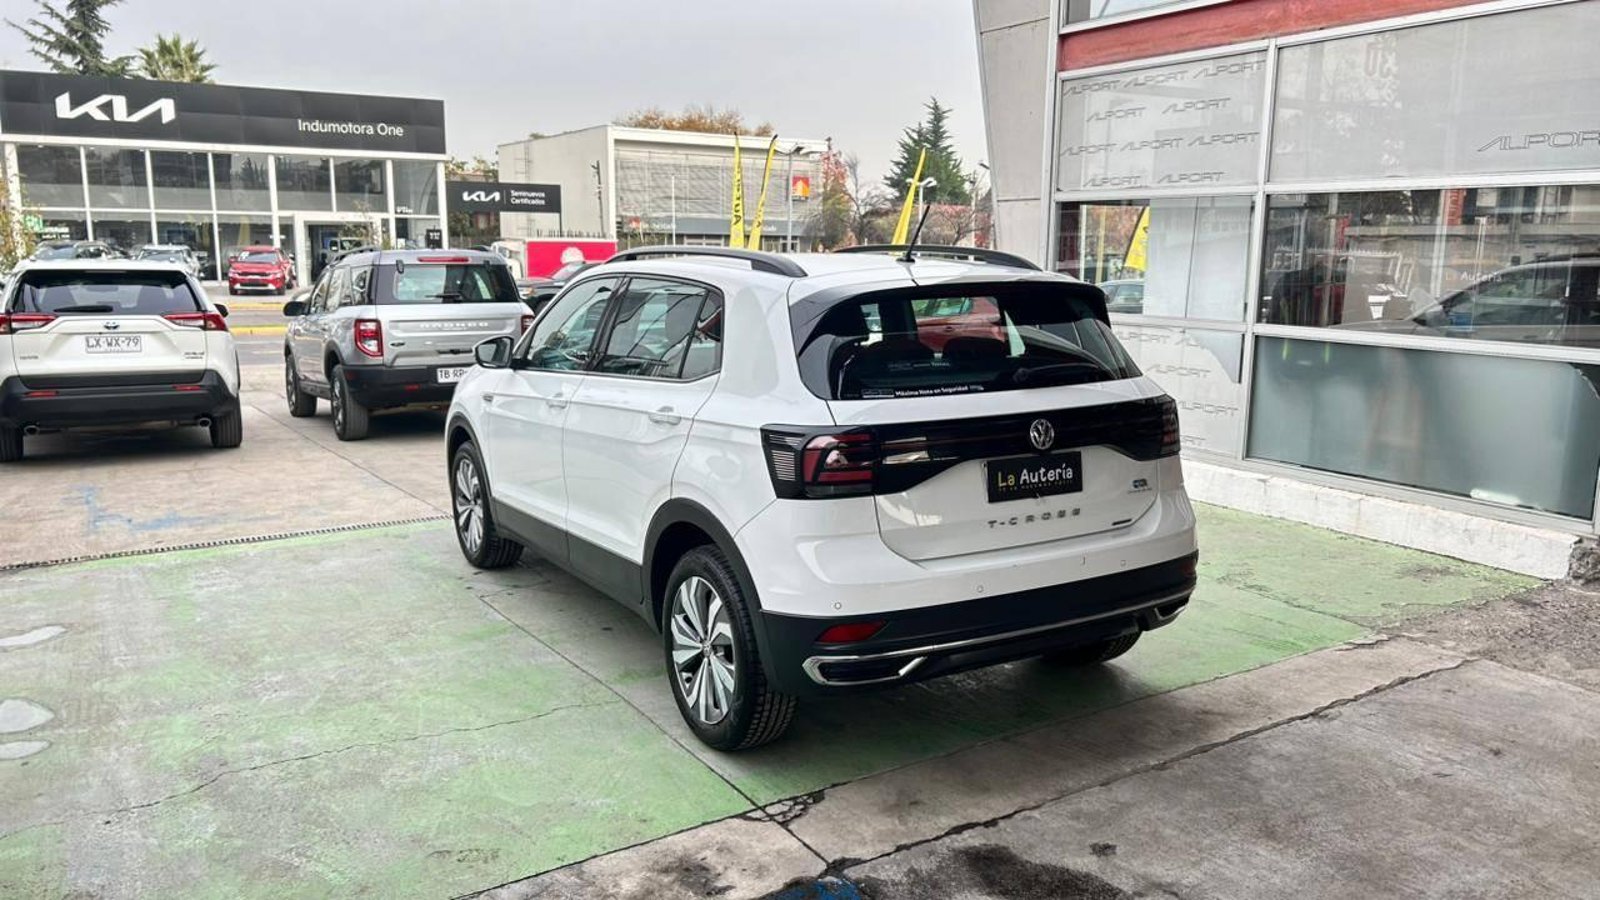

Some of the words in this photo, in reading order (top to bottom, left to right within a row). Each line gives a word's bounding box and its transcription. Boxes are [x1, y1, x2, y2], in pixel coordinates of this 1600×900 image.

[1063, 79, 1120, 97] ALPORT
[1124, 71, 1189, 89] ALPORT
[1193, 60, 1266, 80] ALPORT
[1086, 107, 1147, 122] ALPORT
[1161, 98, 1231, 115] ALPORT
[297, 119, 375, 135] Indumotora
[376, 123, 404, 137] One
[1120, 137, 1183, 151] ALPORT
[1187, 131, 1261, 147] ALPORT
[1083, 175, 1141, 188] ALPORT
[1158, 171, 1225, 184] ALPORT
[997, 471, 1016, 487] La
[1019, 463, 1074, 485] Autería
[987, 507, 1081, 529] T-CROSS
